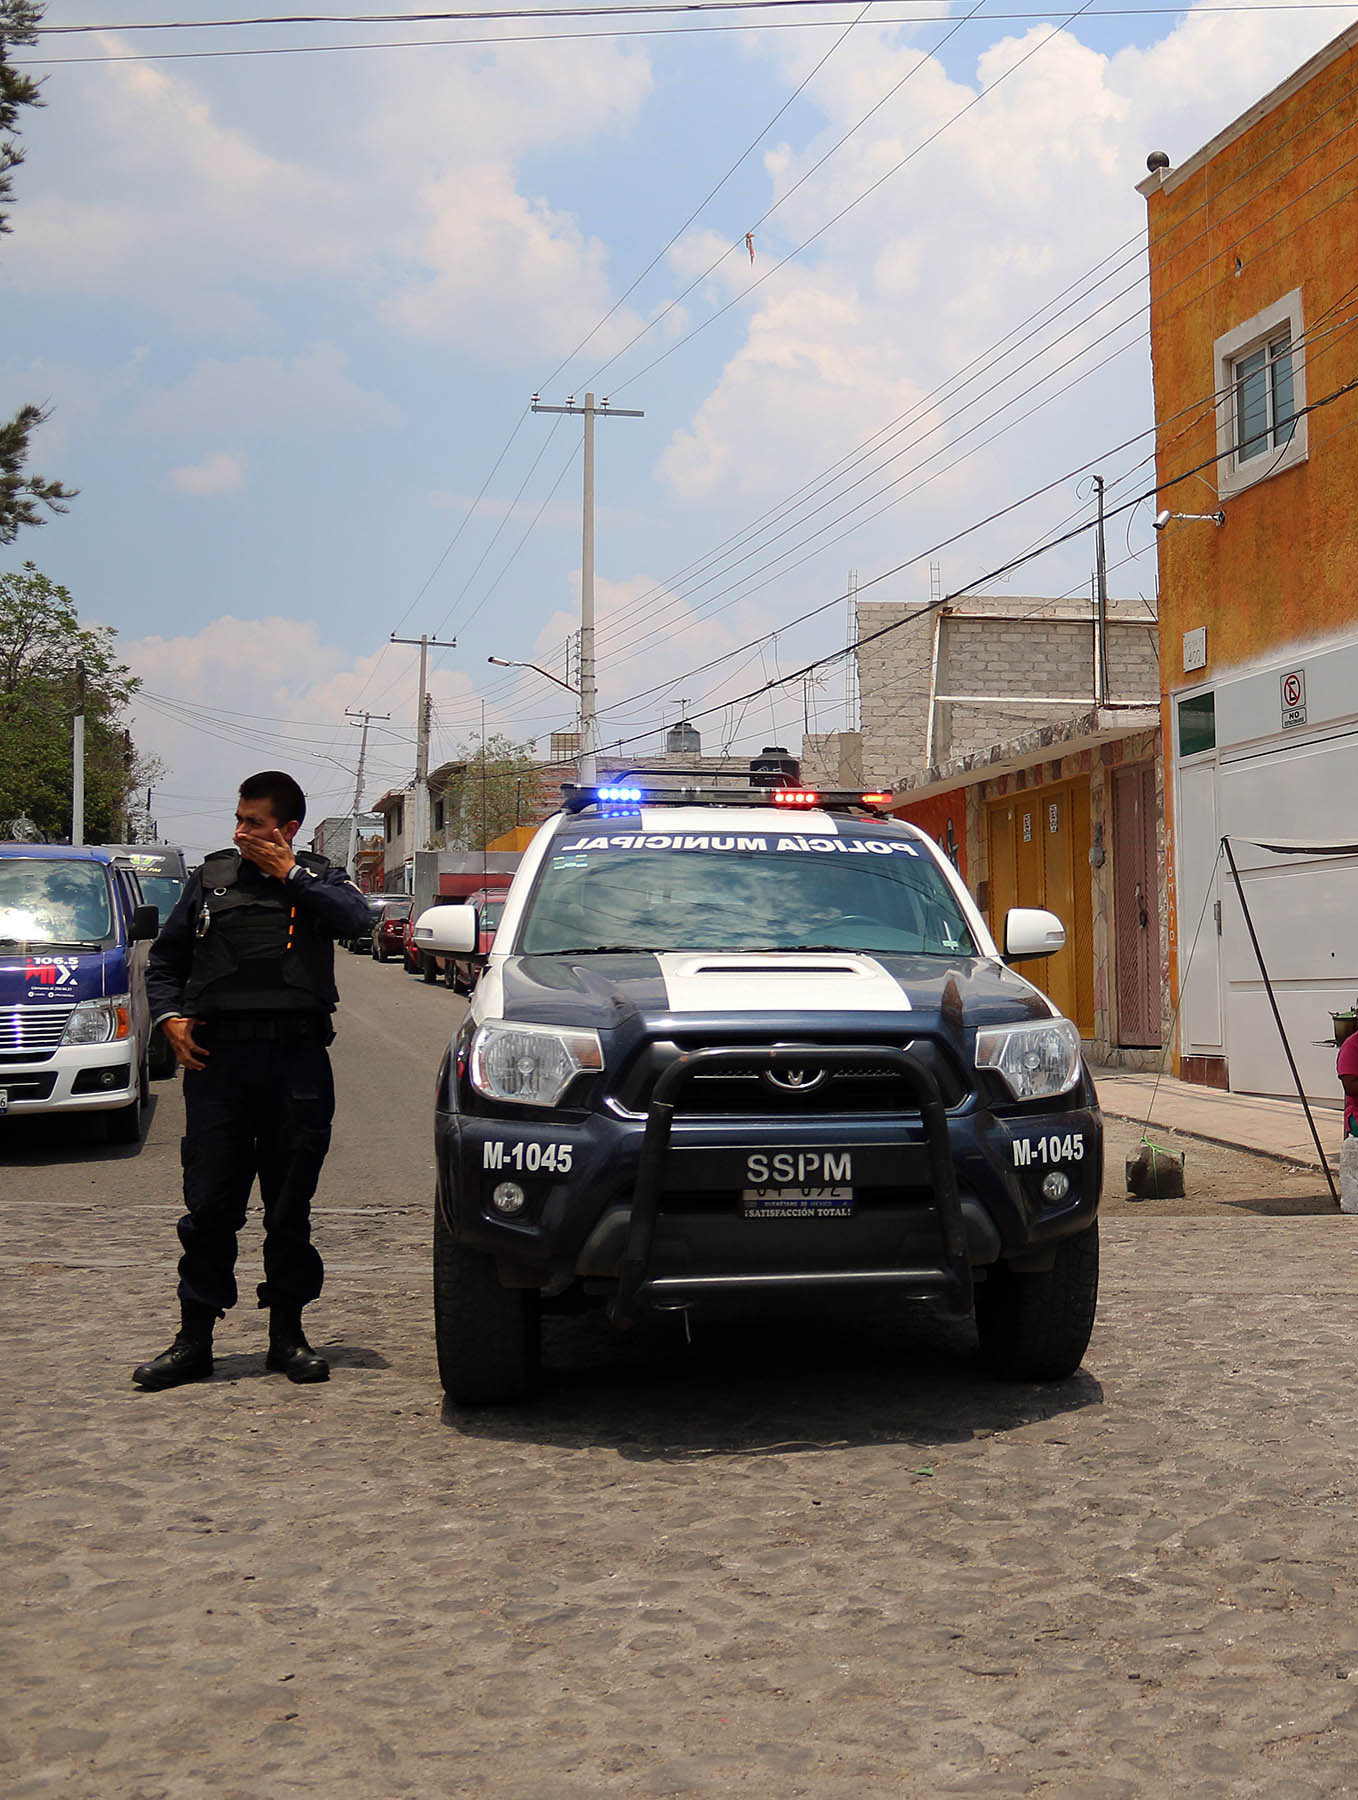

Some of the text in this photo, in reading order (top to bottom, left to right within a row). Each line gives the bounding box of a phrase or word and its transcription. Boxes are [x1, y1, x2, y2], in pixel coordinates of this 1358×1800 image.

[1288, 711, 1300, 720] NO
[33, 957, 79, 965] 106.5
[25, 964, 79, 985] MIX
[483, 1141, 573, 1173] M-1045
[1012, 1133, 1084, 1166] M-1045
[746, 1152, 852, 1183] SSPM
[816, 1208, 852, 1217] TOTAL!
